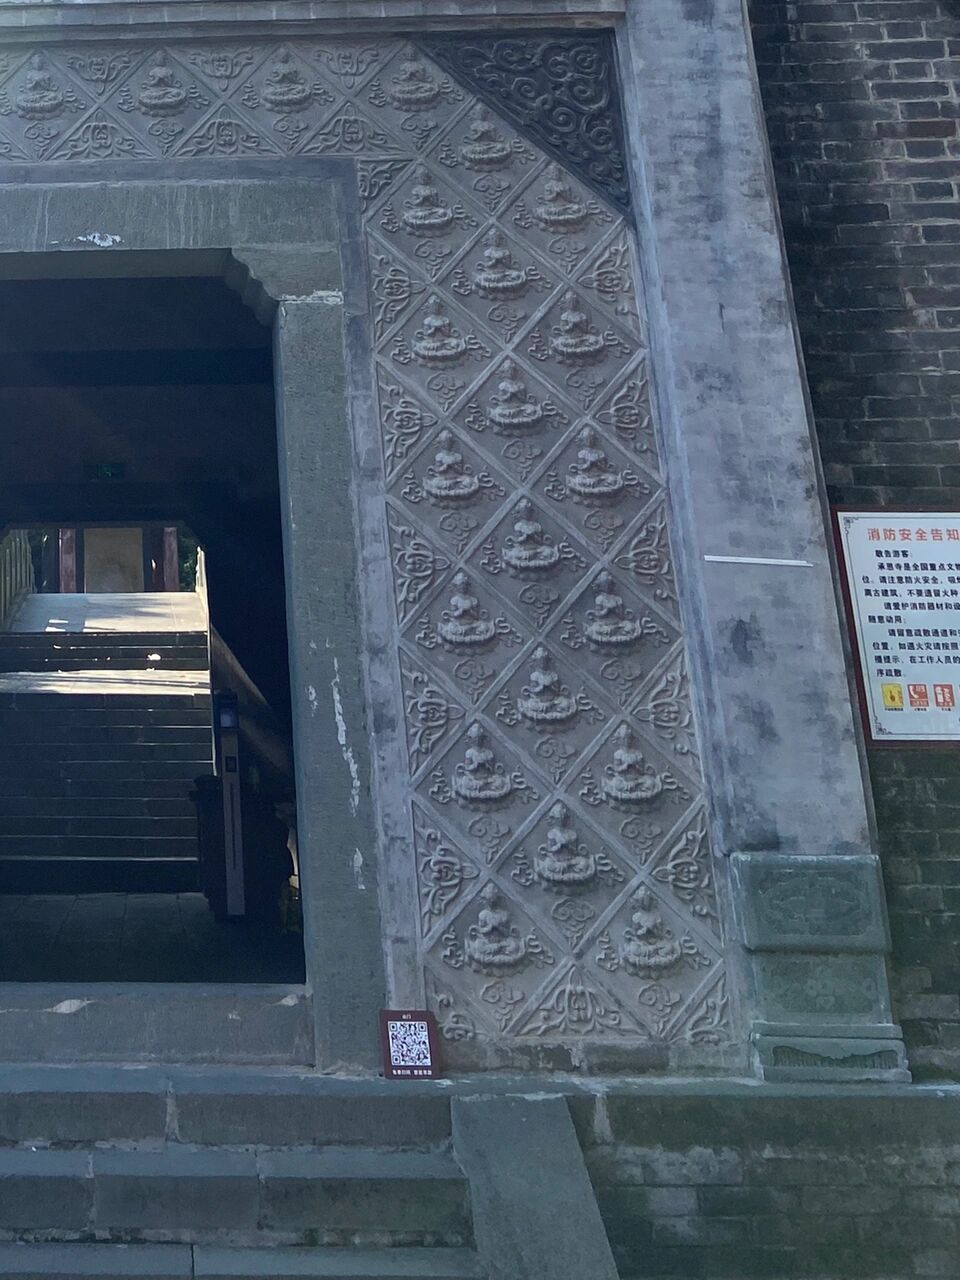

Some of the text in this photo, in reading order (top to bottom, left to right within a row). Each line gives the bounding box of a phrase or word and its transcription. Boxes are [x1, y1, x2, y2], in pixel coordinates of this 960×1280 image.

[888, 628, 960, 638] 请留意疏散通道和
